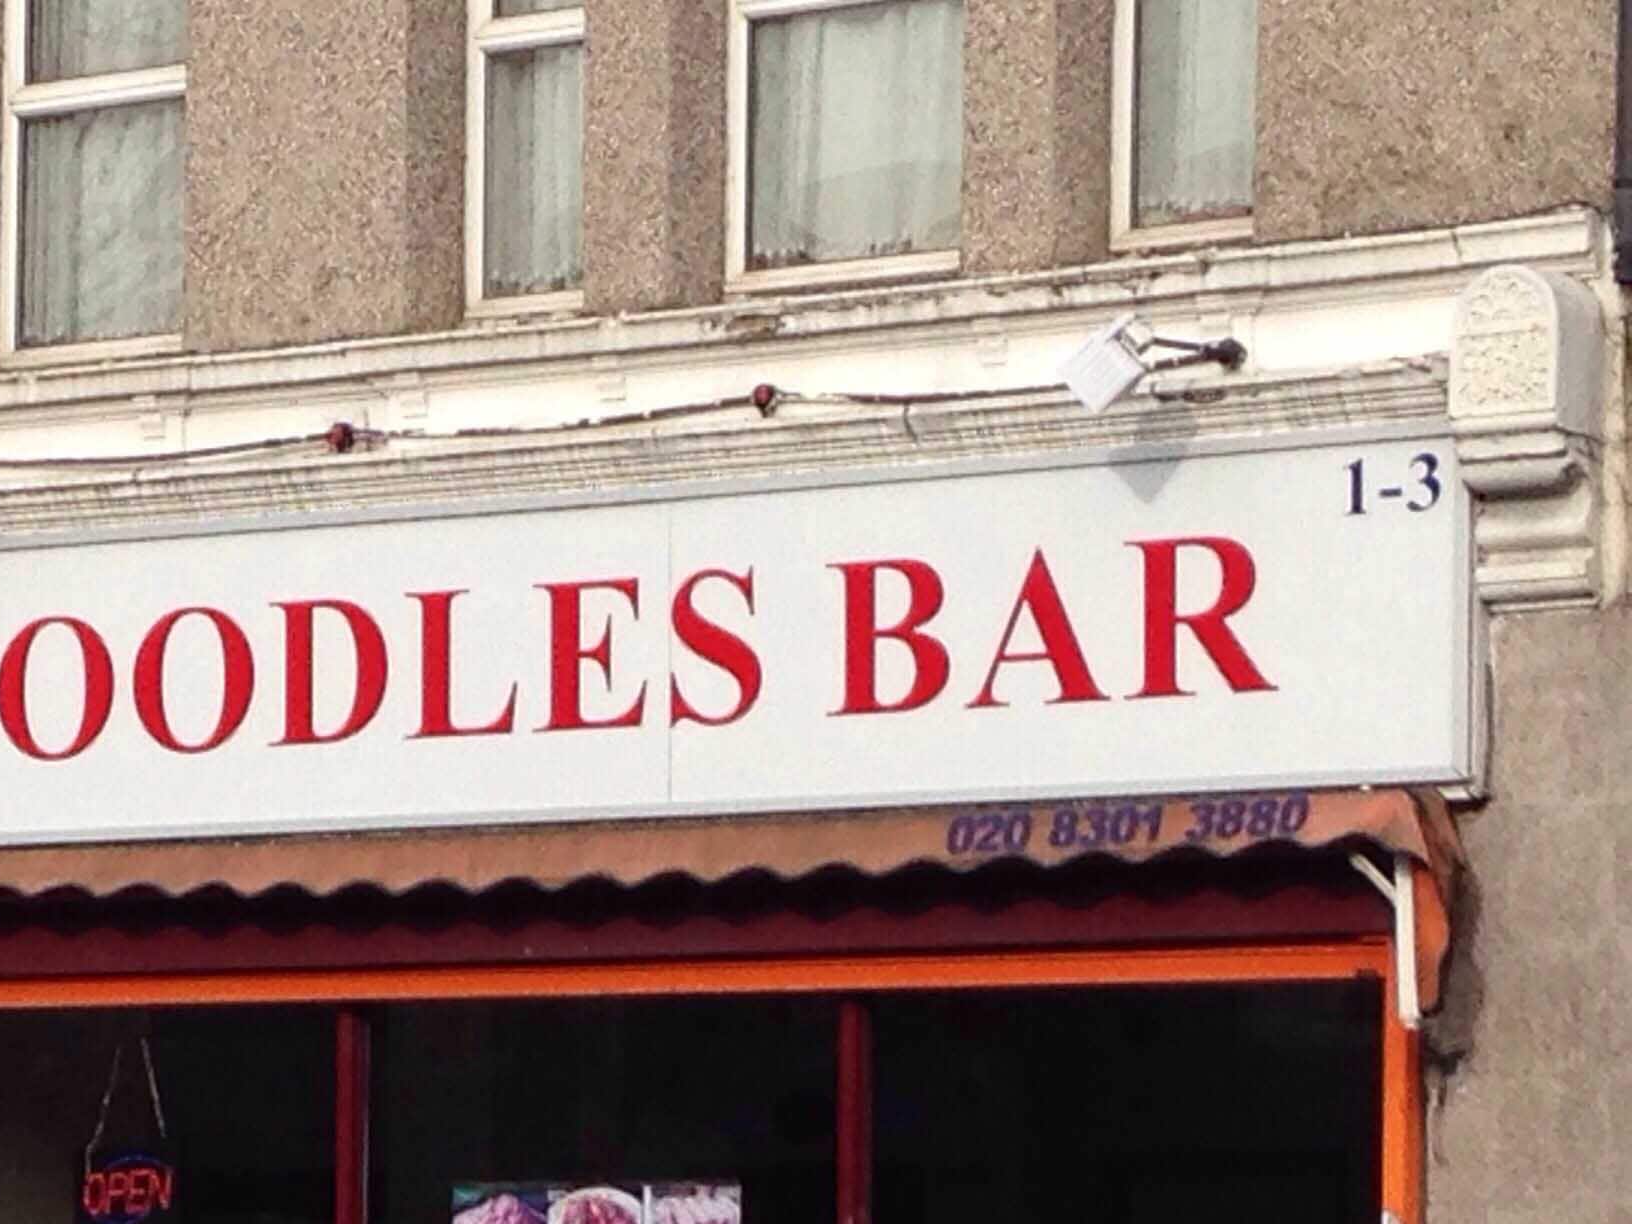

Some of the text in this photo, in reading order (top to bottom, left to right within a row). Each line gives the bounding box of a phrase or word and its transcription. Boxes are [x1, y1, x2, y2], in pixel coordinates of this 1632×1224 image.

[1342, 452, 1442, 516] 1-3
[825, 536, 1280, 716] BAR
[946, 793, 1309, 857] 020 8301 3880
[82, 1166, 173, 1216] OPEN
